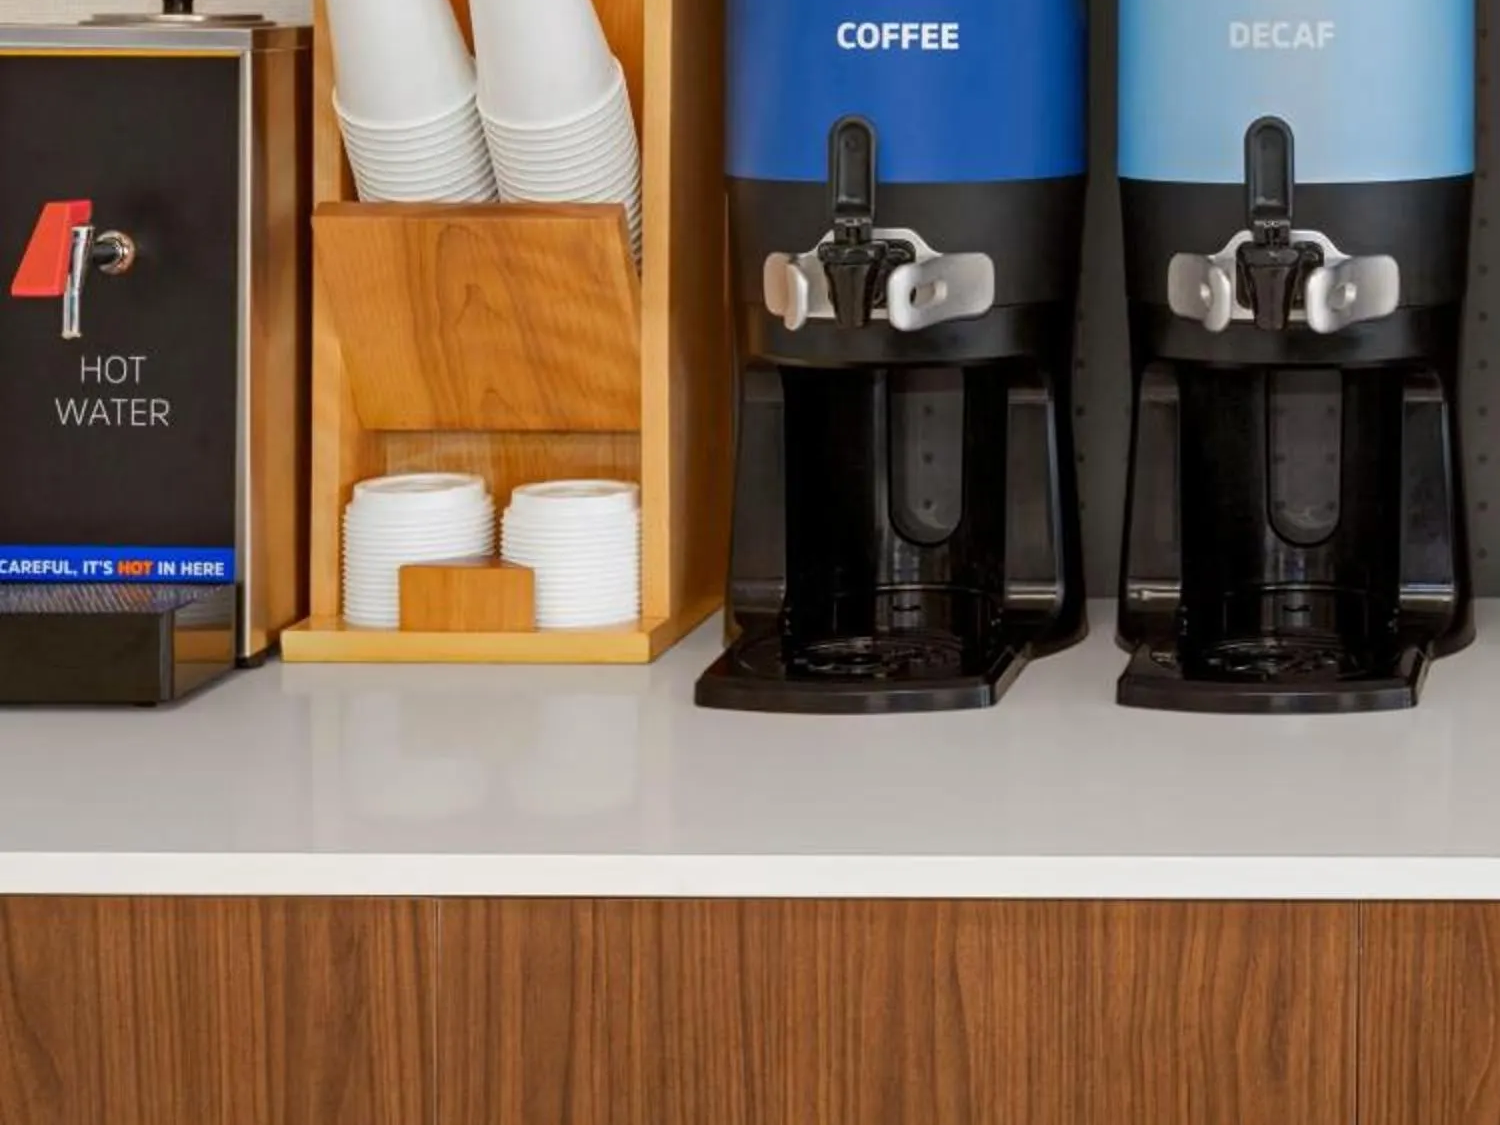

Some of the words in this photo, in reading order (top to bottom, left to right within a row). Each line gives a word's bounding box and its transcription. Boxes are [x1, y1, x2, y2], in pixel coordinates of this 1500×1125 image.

[836, 22, 960, 50] COFFEE
[1228, 21, 1335, 50] DECAF
[80, 355, 147, 384] HOT
[54, 397, 170, 426] WATER
[83, 560, 113, 575] IT'S
[118, 561, 153, 575] HOT
[158, 561, 175, 575] IN
[180, 562, 225, 576] HERE
